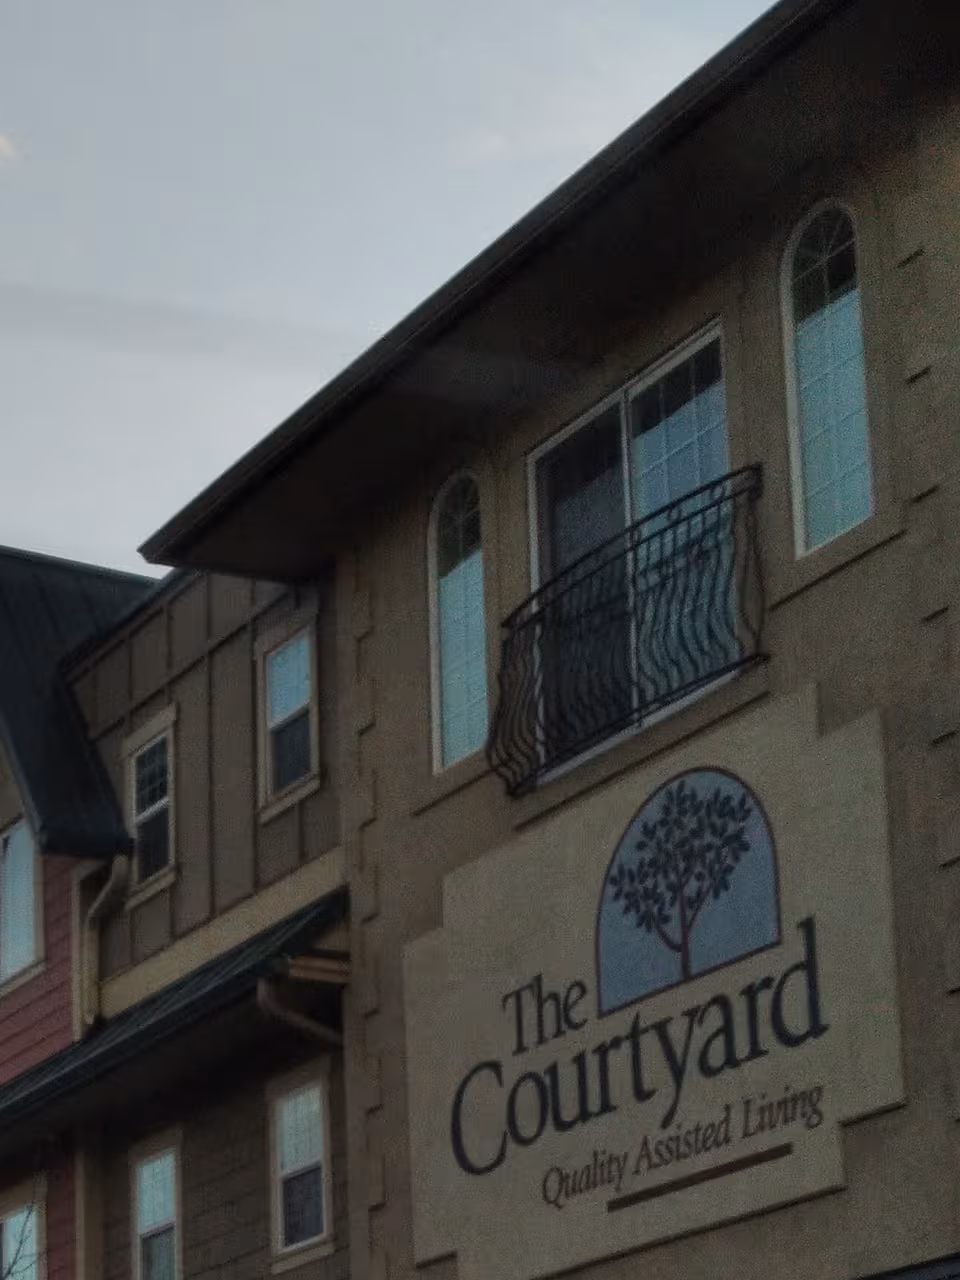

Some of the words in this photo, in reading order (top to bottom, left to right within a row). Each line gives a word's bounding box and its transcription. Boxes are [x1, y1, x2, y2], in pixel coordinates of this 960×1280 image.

[451, 915, 829, 1177] Courtyard
[502, 974, 587, 1055] The
[542, 1150, 629, 1209] Quality
[632, 1104, 732, 1177] Assisted
[740, 1085, 824, 1140] Living
